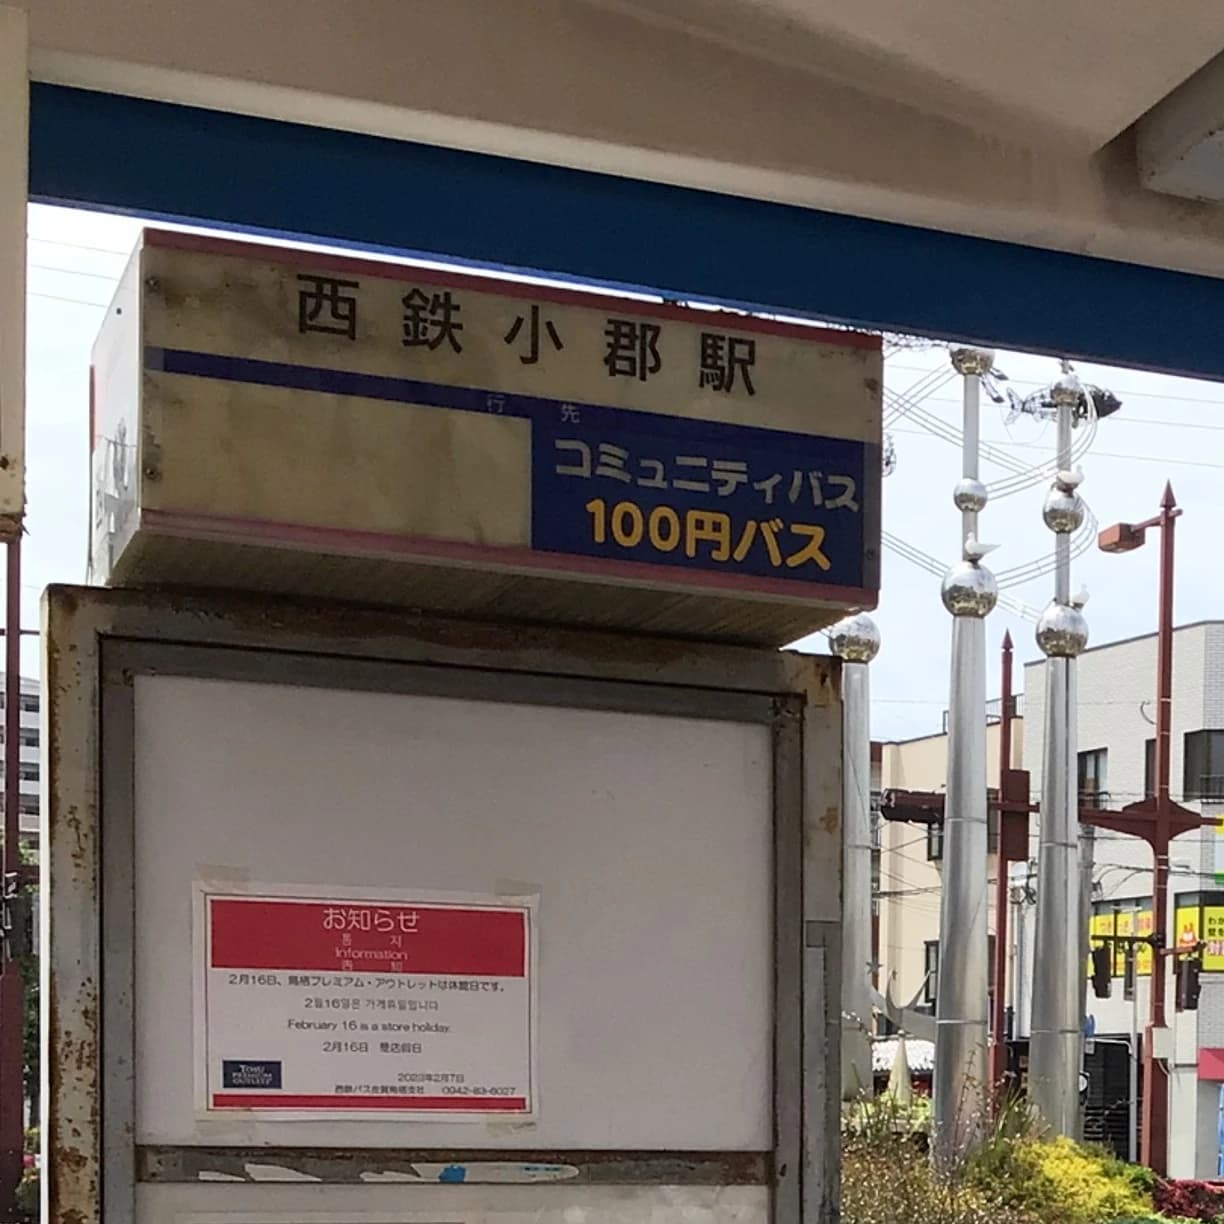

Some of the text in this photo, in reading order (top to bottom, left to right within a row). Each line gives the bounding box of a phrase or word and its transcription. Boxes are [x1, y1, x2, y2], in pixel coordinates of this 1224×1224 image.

[296, 273, 757, 396] 西鉄小郡駅
[554, 438, 860, 513] コミュニティバス
[585, 498, 831, 572] 100円バス
[323, 909, 420, 933] お知らせ
[335, 947, 408, 961] Information
[287, 1018, 337, 1032] February
[342, 1020, 357, 1031] 16
[322, 1041, 369, 1053] 2月16日
